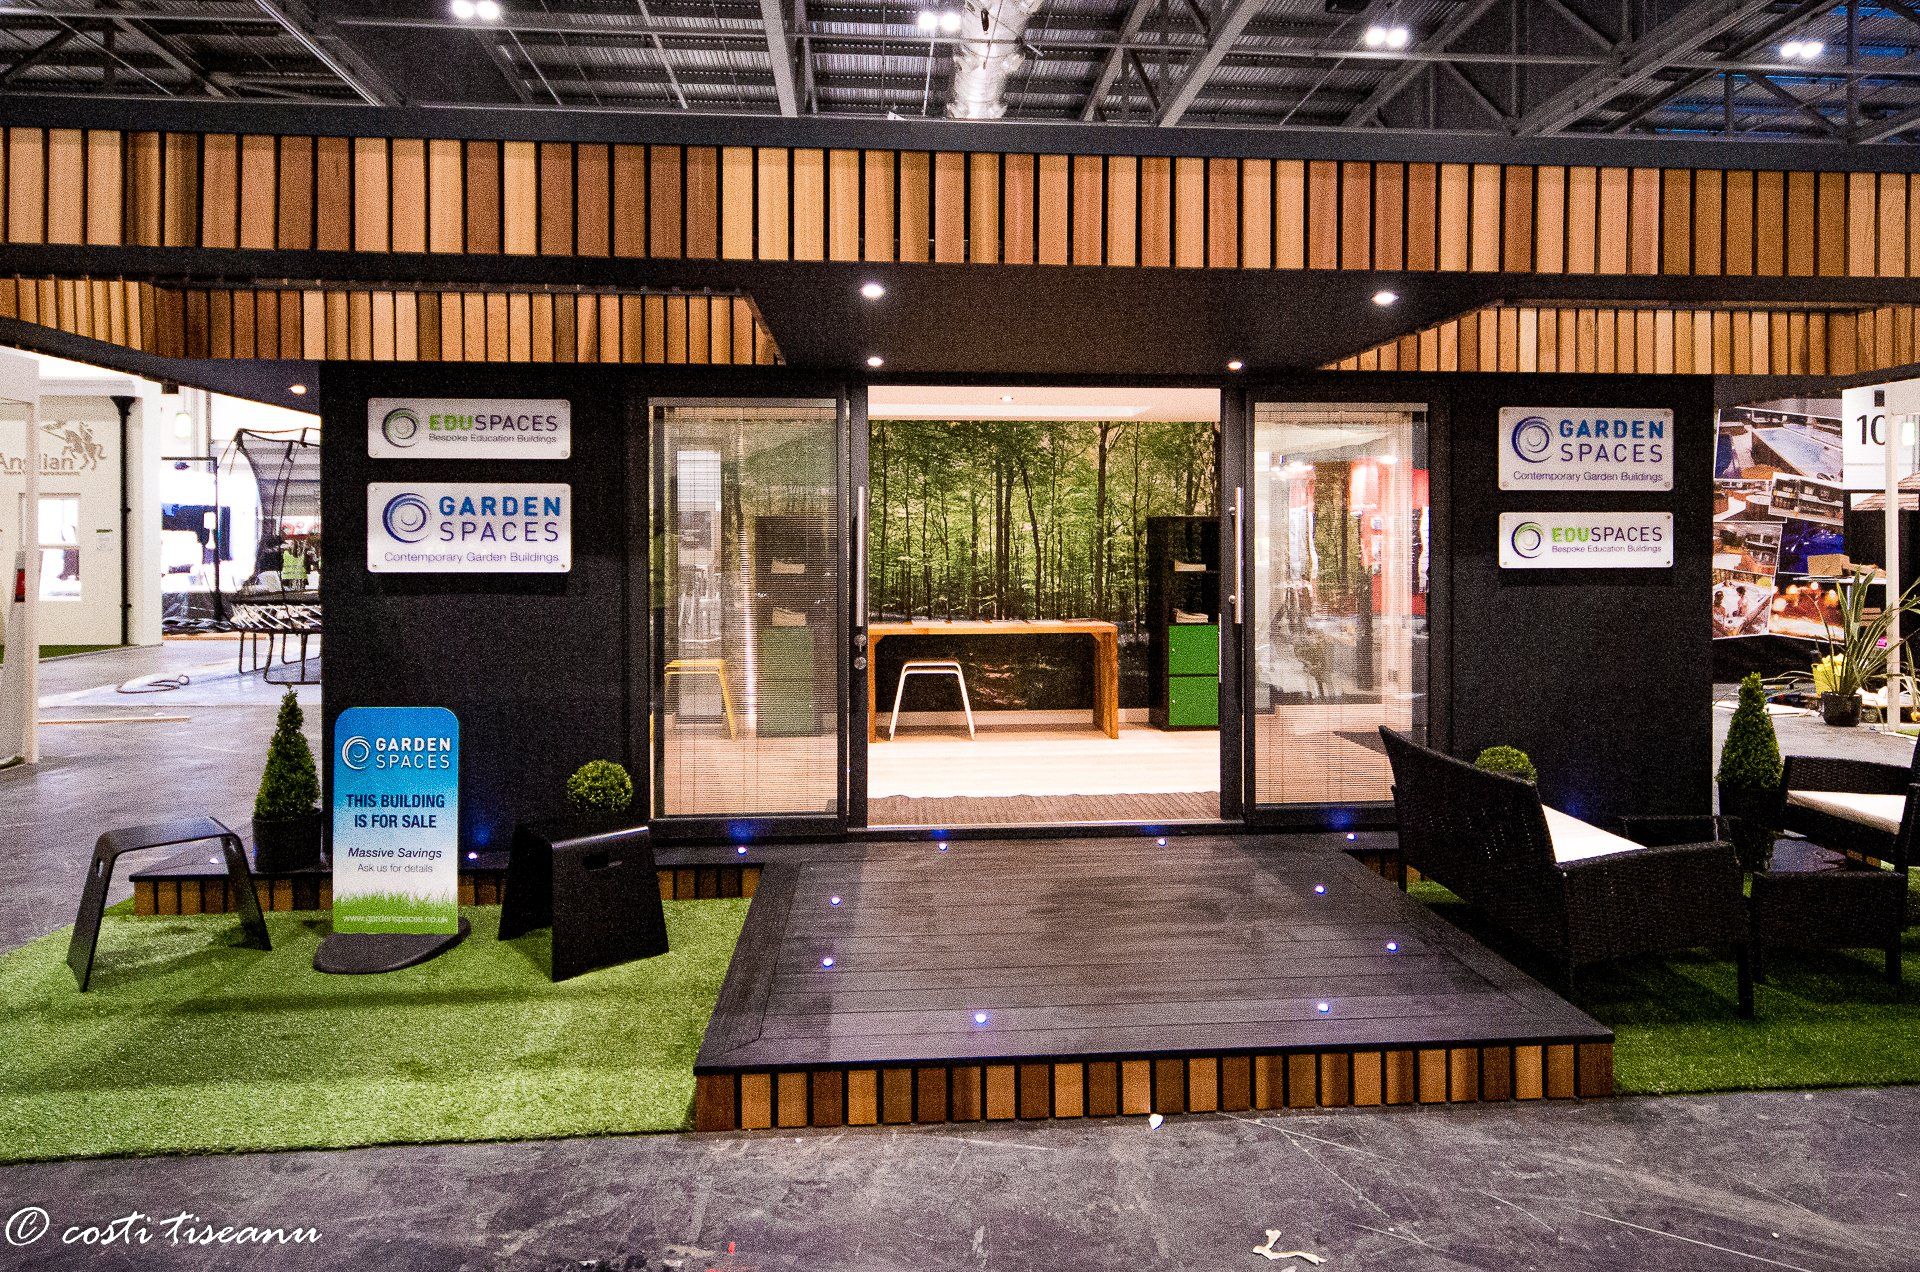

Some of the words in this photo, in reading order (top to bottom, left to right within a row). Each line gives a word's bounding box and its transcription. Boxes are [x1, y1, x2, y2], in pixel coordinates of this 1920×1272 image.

[428, 414, 558, 432] EDUSPACES
[1558, 419, 1664, 439] GARDEN
[429, 433, 468, 443] Bespoke
[470, 433, 515, 442] Education
[517, 434, 557, 444] Buildings
[1560, 443, 1663, 463] SPACES
[1513, 470, 1581, 482] Contemporary
[1583, 471, 1618, 481] Garden
[1621, 472, 1663, 483] Buildings
[439, 496, 561, 517] GARDEN
[439, 521, 559, 542] SPACES
[1551, 526, 1663, 543] EDUSPACES
[1552, 545, 1585, 555] Bespoke
[1587, 545, 1625, 553] Education
[1627, 545, 1662, 554] Buildings
[384, 552, 464, 563] Contemporary
[466, 552, 507, 562] Garden
[510, 552, 560, 564] Buildings
[375, 737, 451, 752] GARDEN
[376, 754, 450, 769] SPACES
[346, 793, 376, 808] THIS
[380, 794, 445, 808] BUILDING
[354, 814, 367, 828] IS
[371, 814, 398, 828] FOR
[402, 814, 437, 829] SALE
[348, 847, 395, 858] Massive
[397, 848, 442, 859] Savings
[357, 863, 374, 873] Ask
[377, 865, 388, 873] us
[390, 863, 402, 873] for
[404, 864, 433, 873] details
